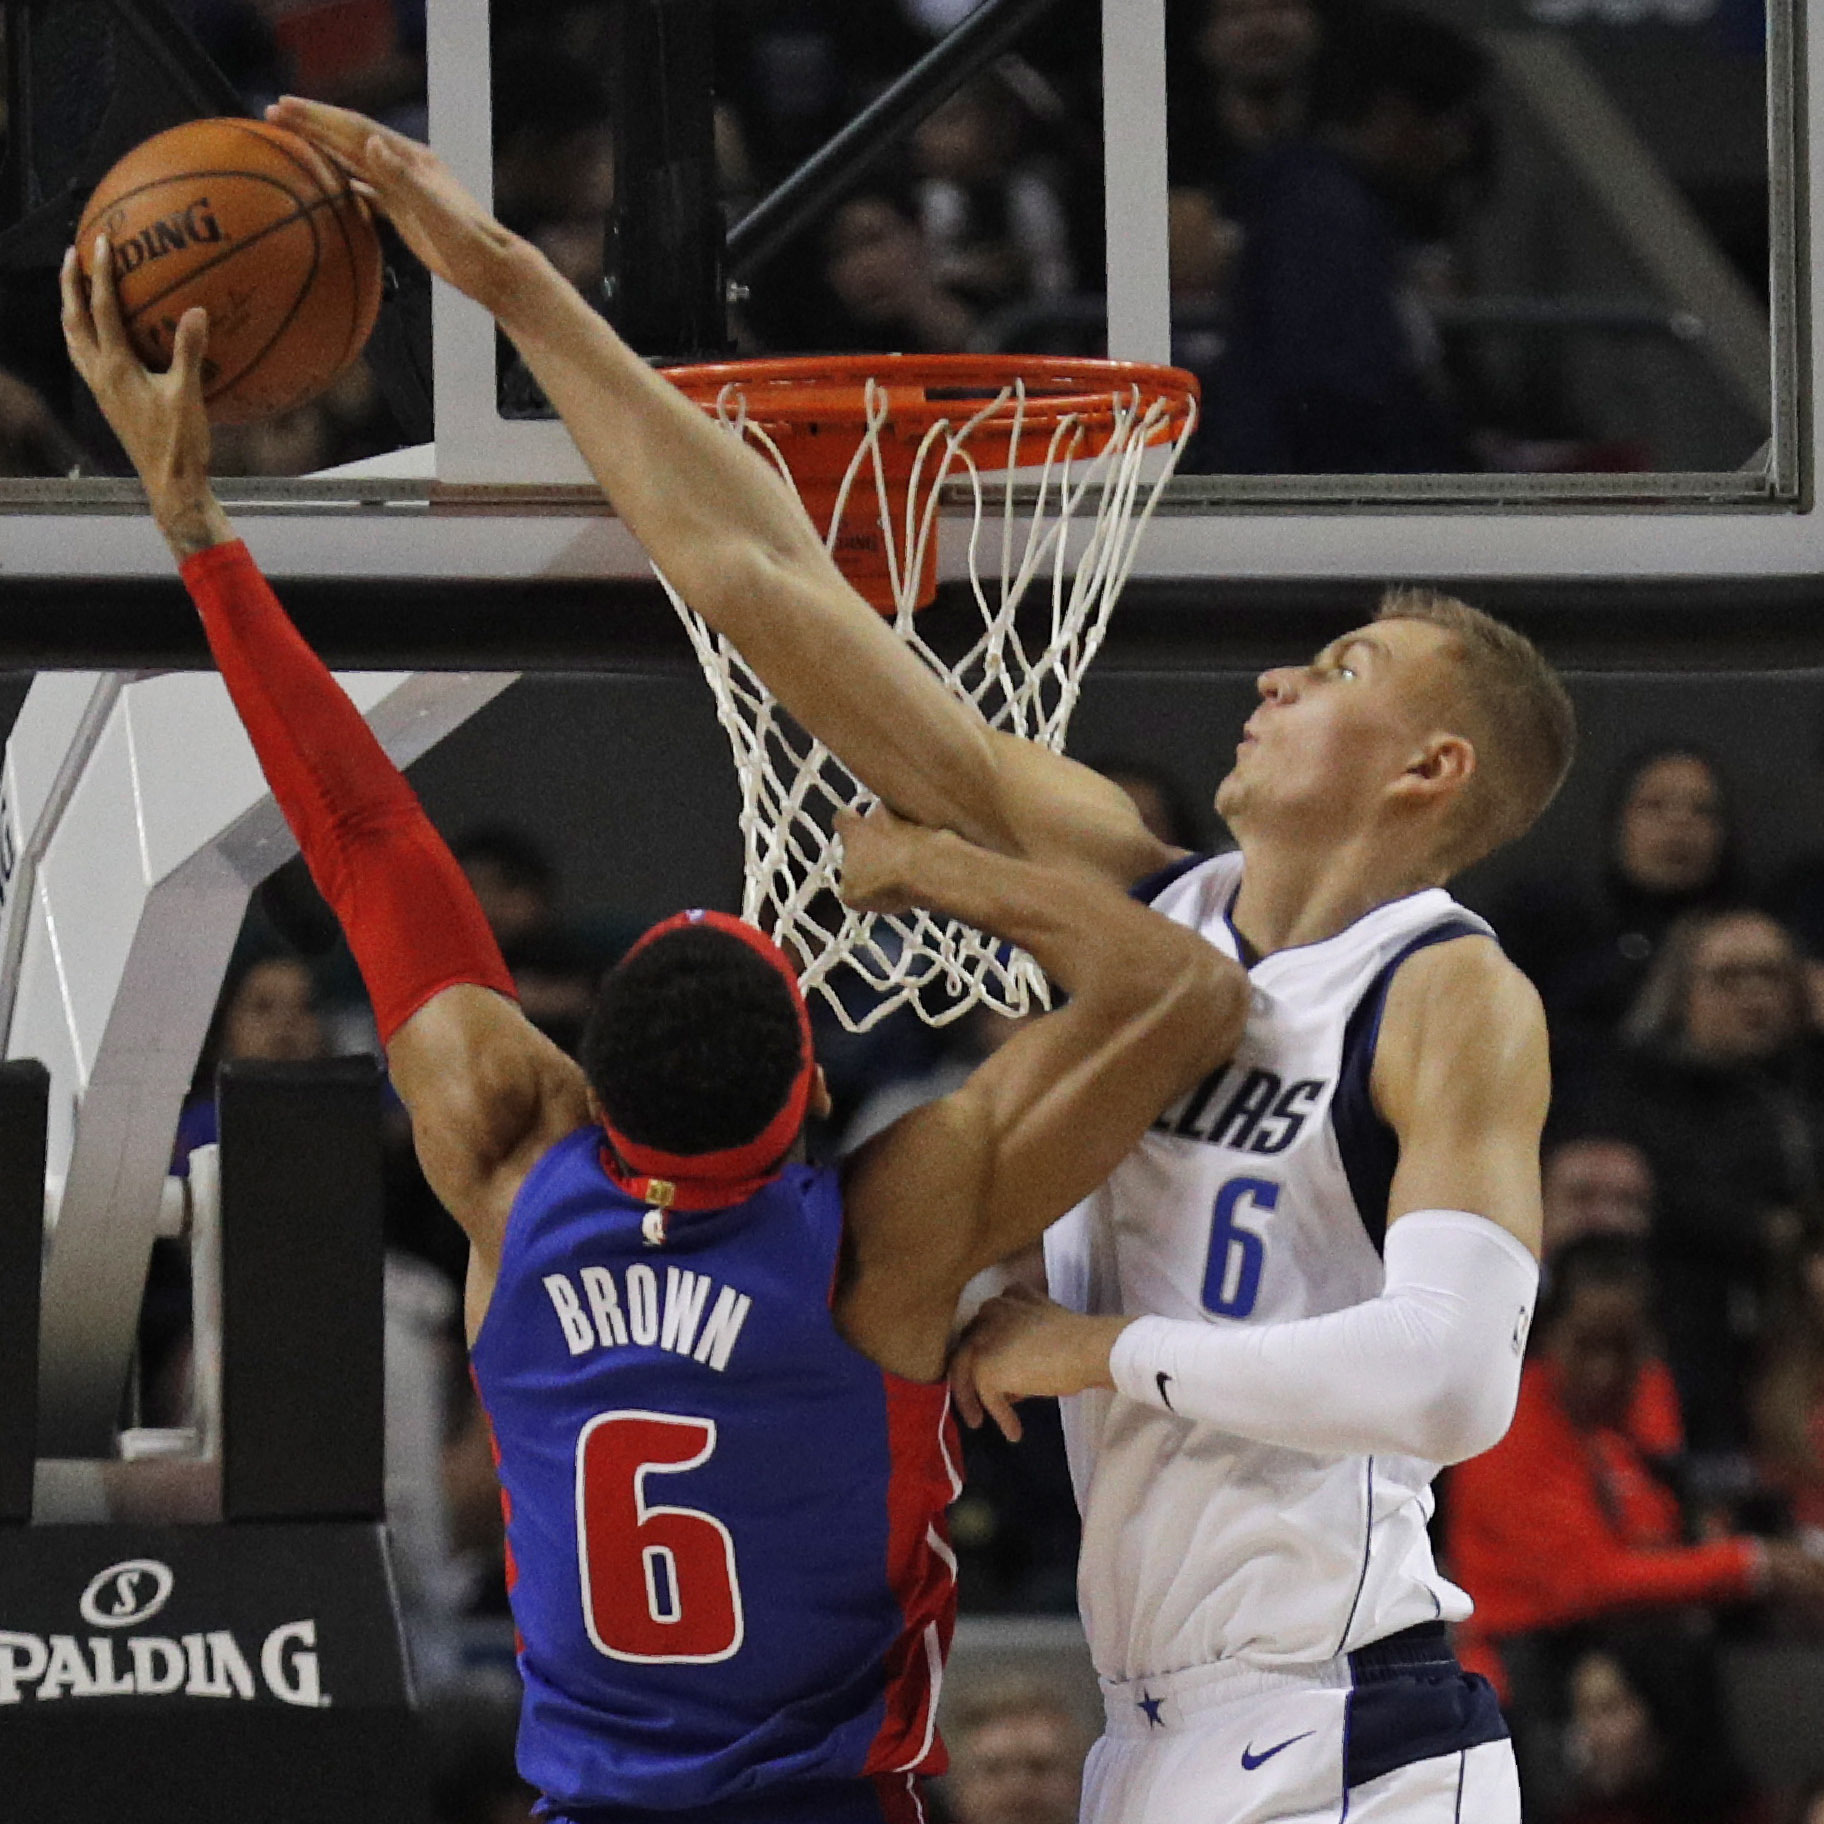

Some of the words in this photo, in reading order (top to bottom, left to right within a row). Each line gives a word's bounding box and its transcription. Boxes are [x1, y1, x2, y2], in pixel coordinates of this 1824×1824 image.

[542, 1261, 752, 1373] BROWN
[1201, 1176, 1280, 1319] 6
[574, 1408, 745, 1665] 6
